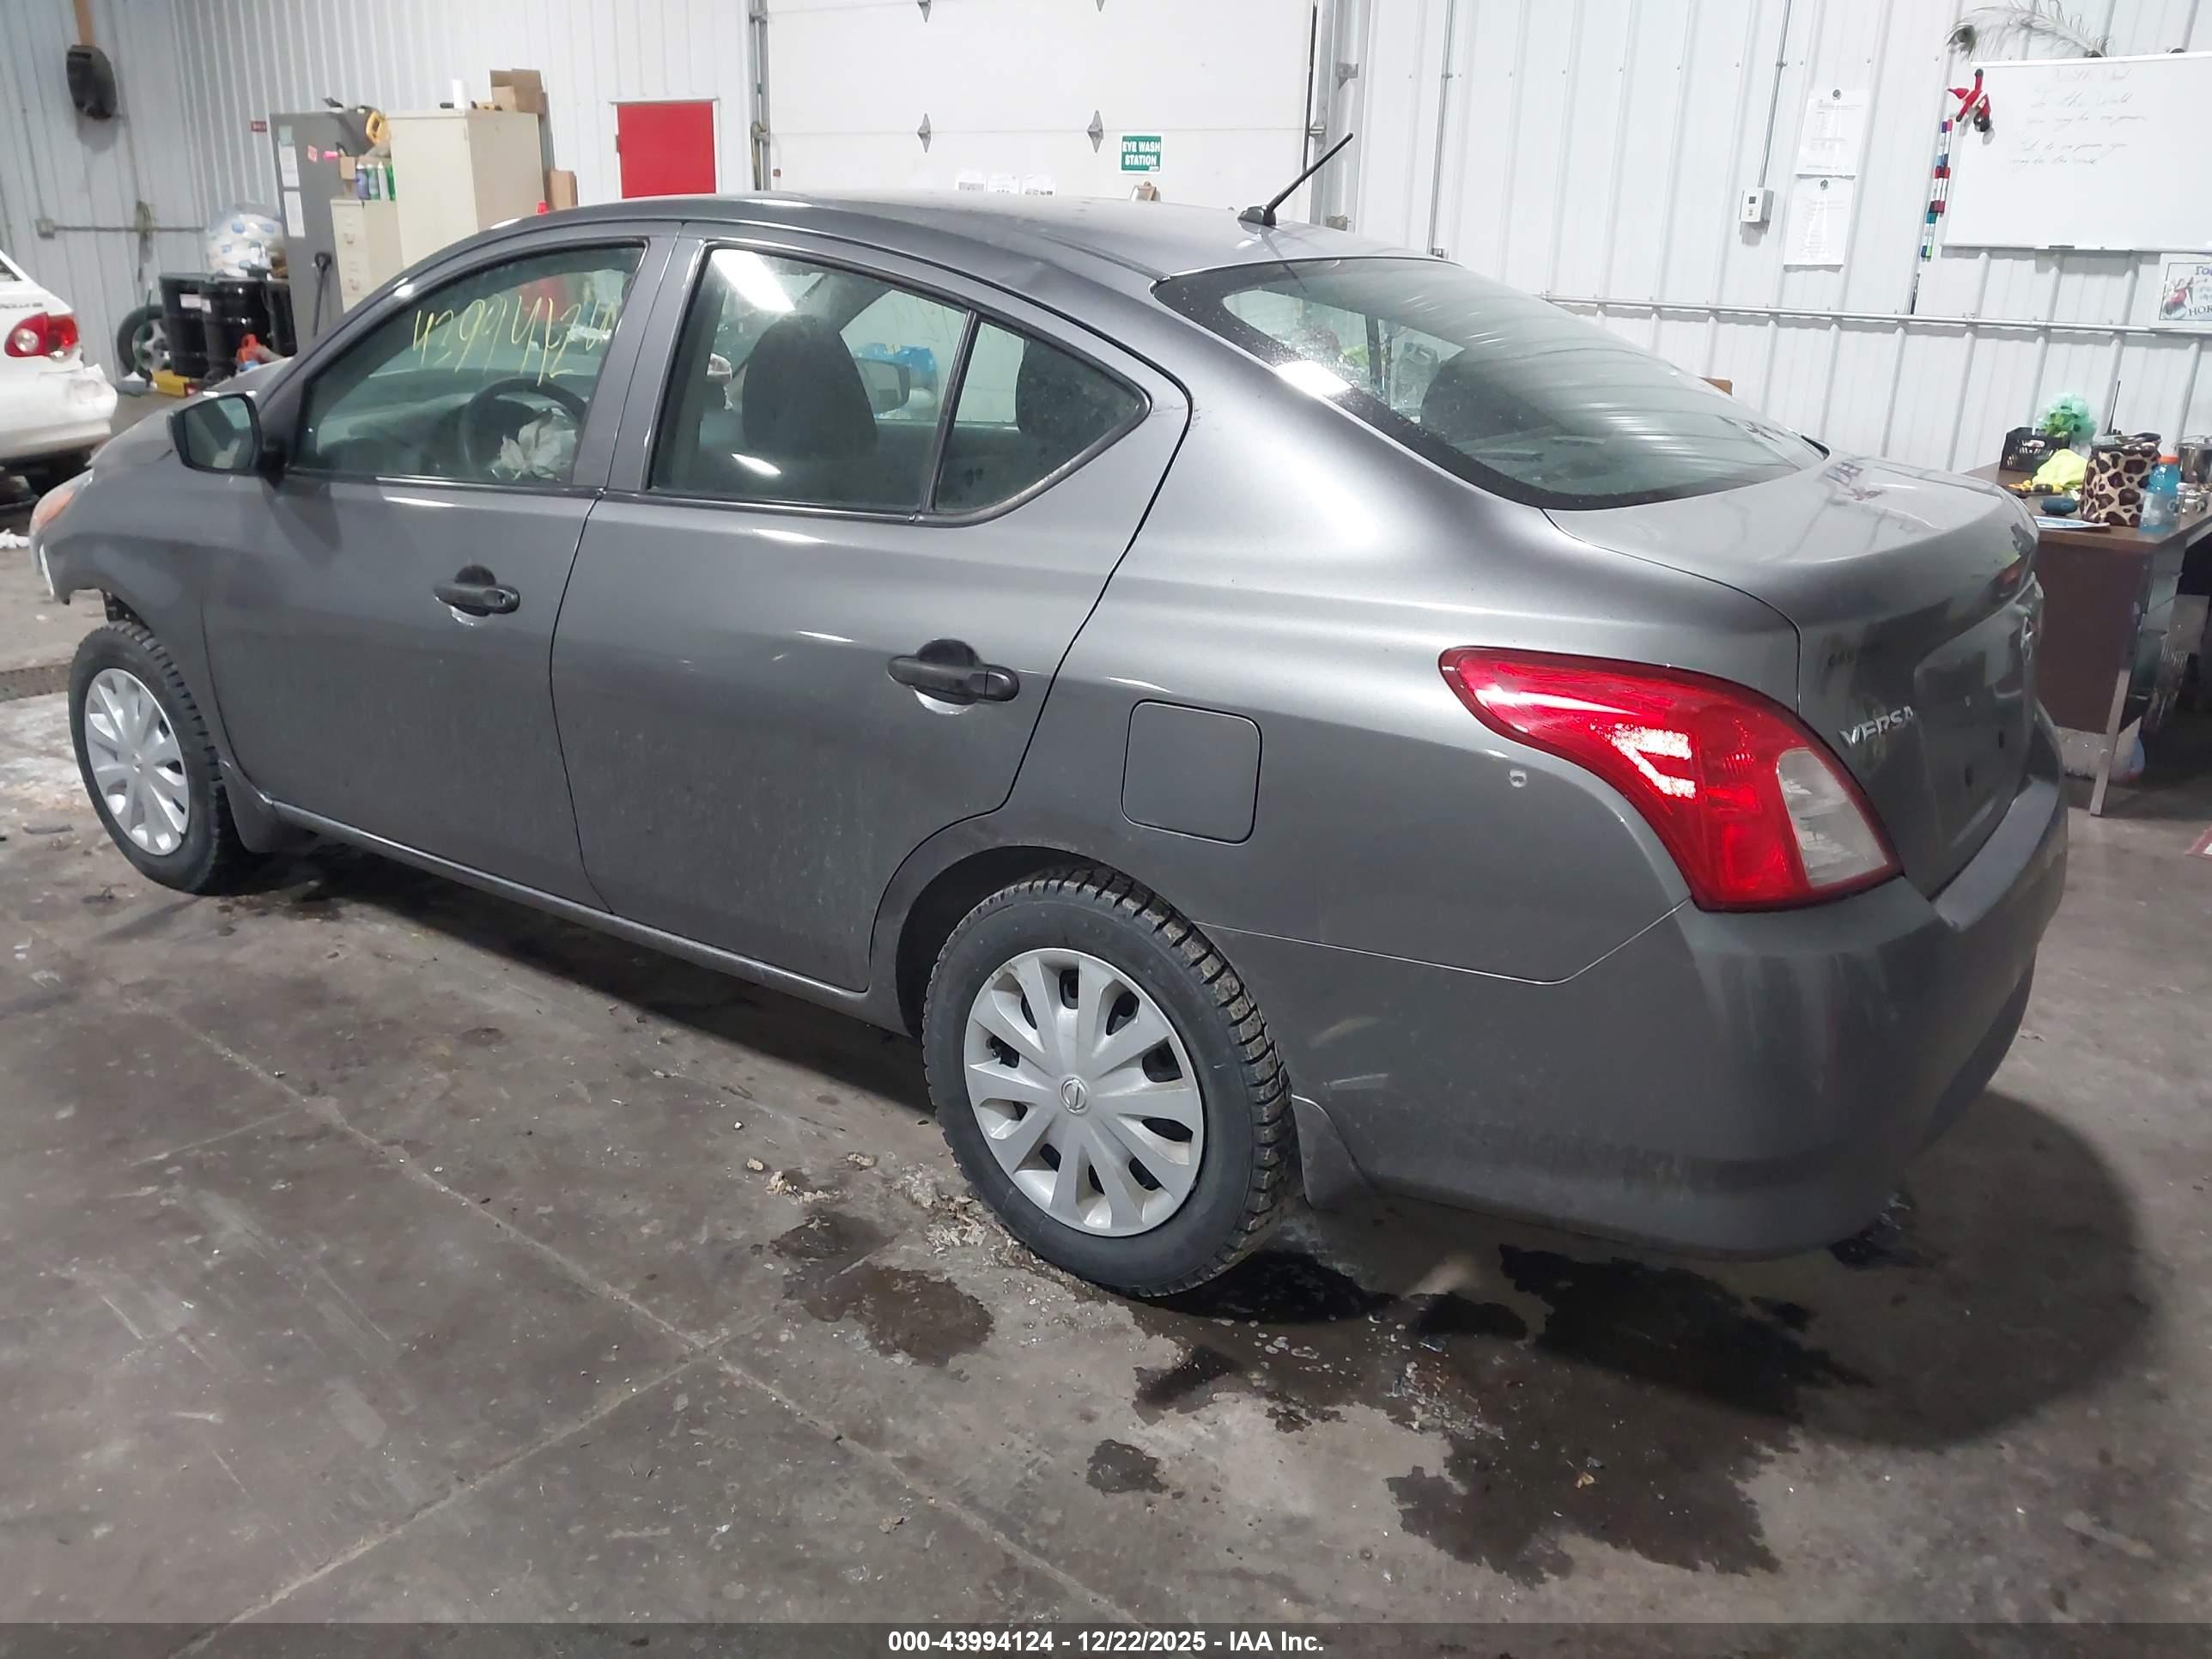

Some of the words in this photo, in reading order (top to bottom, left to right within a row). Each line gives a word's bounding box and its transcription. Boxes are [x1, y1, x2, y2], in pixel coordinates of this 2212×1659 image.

[1122, 142, 1137, 152] EYE
[1139, 142, 1161, 152] WASH
[1125, 155, 1157, 166] STATION
[1838, 705, 1914, 747] VERSA
